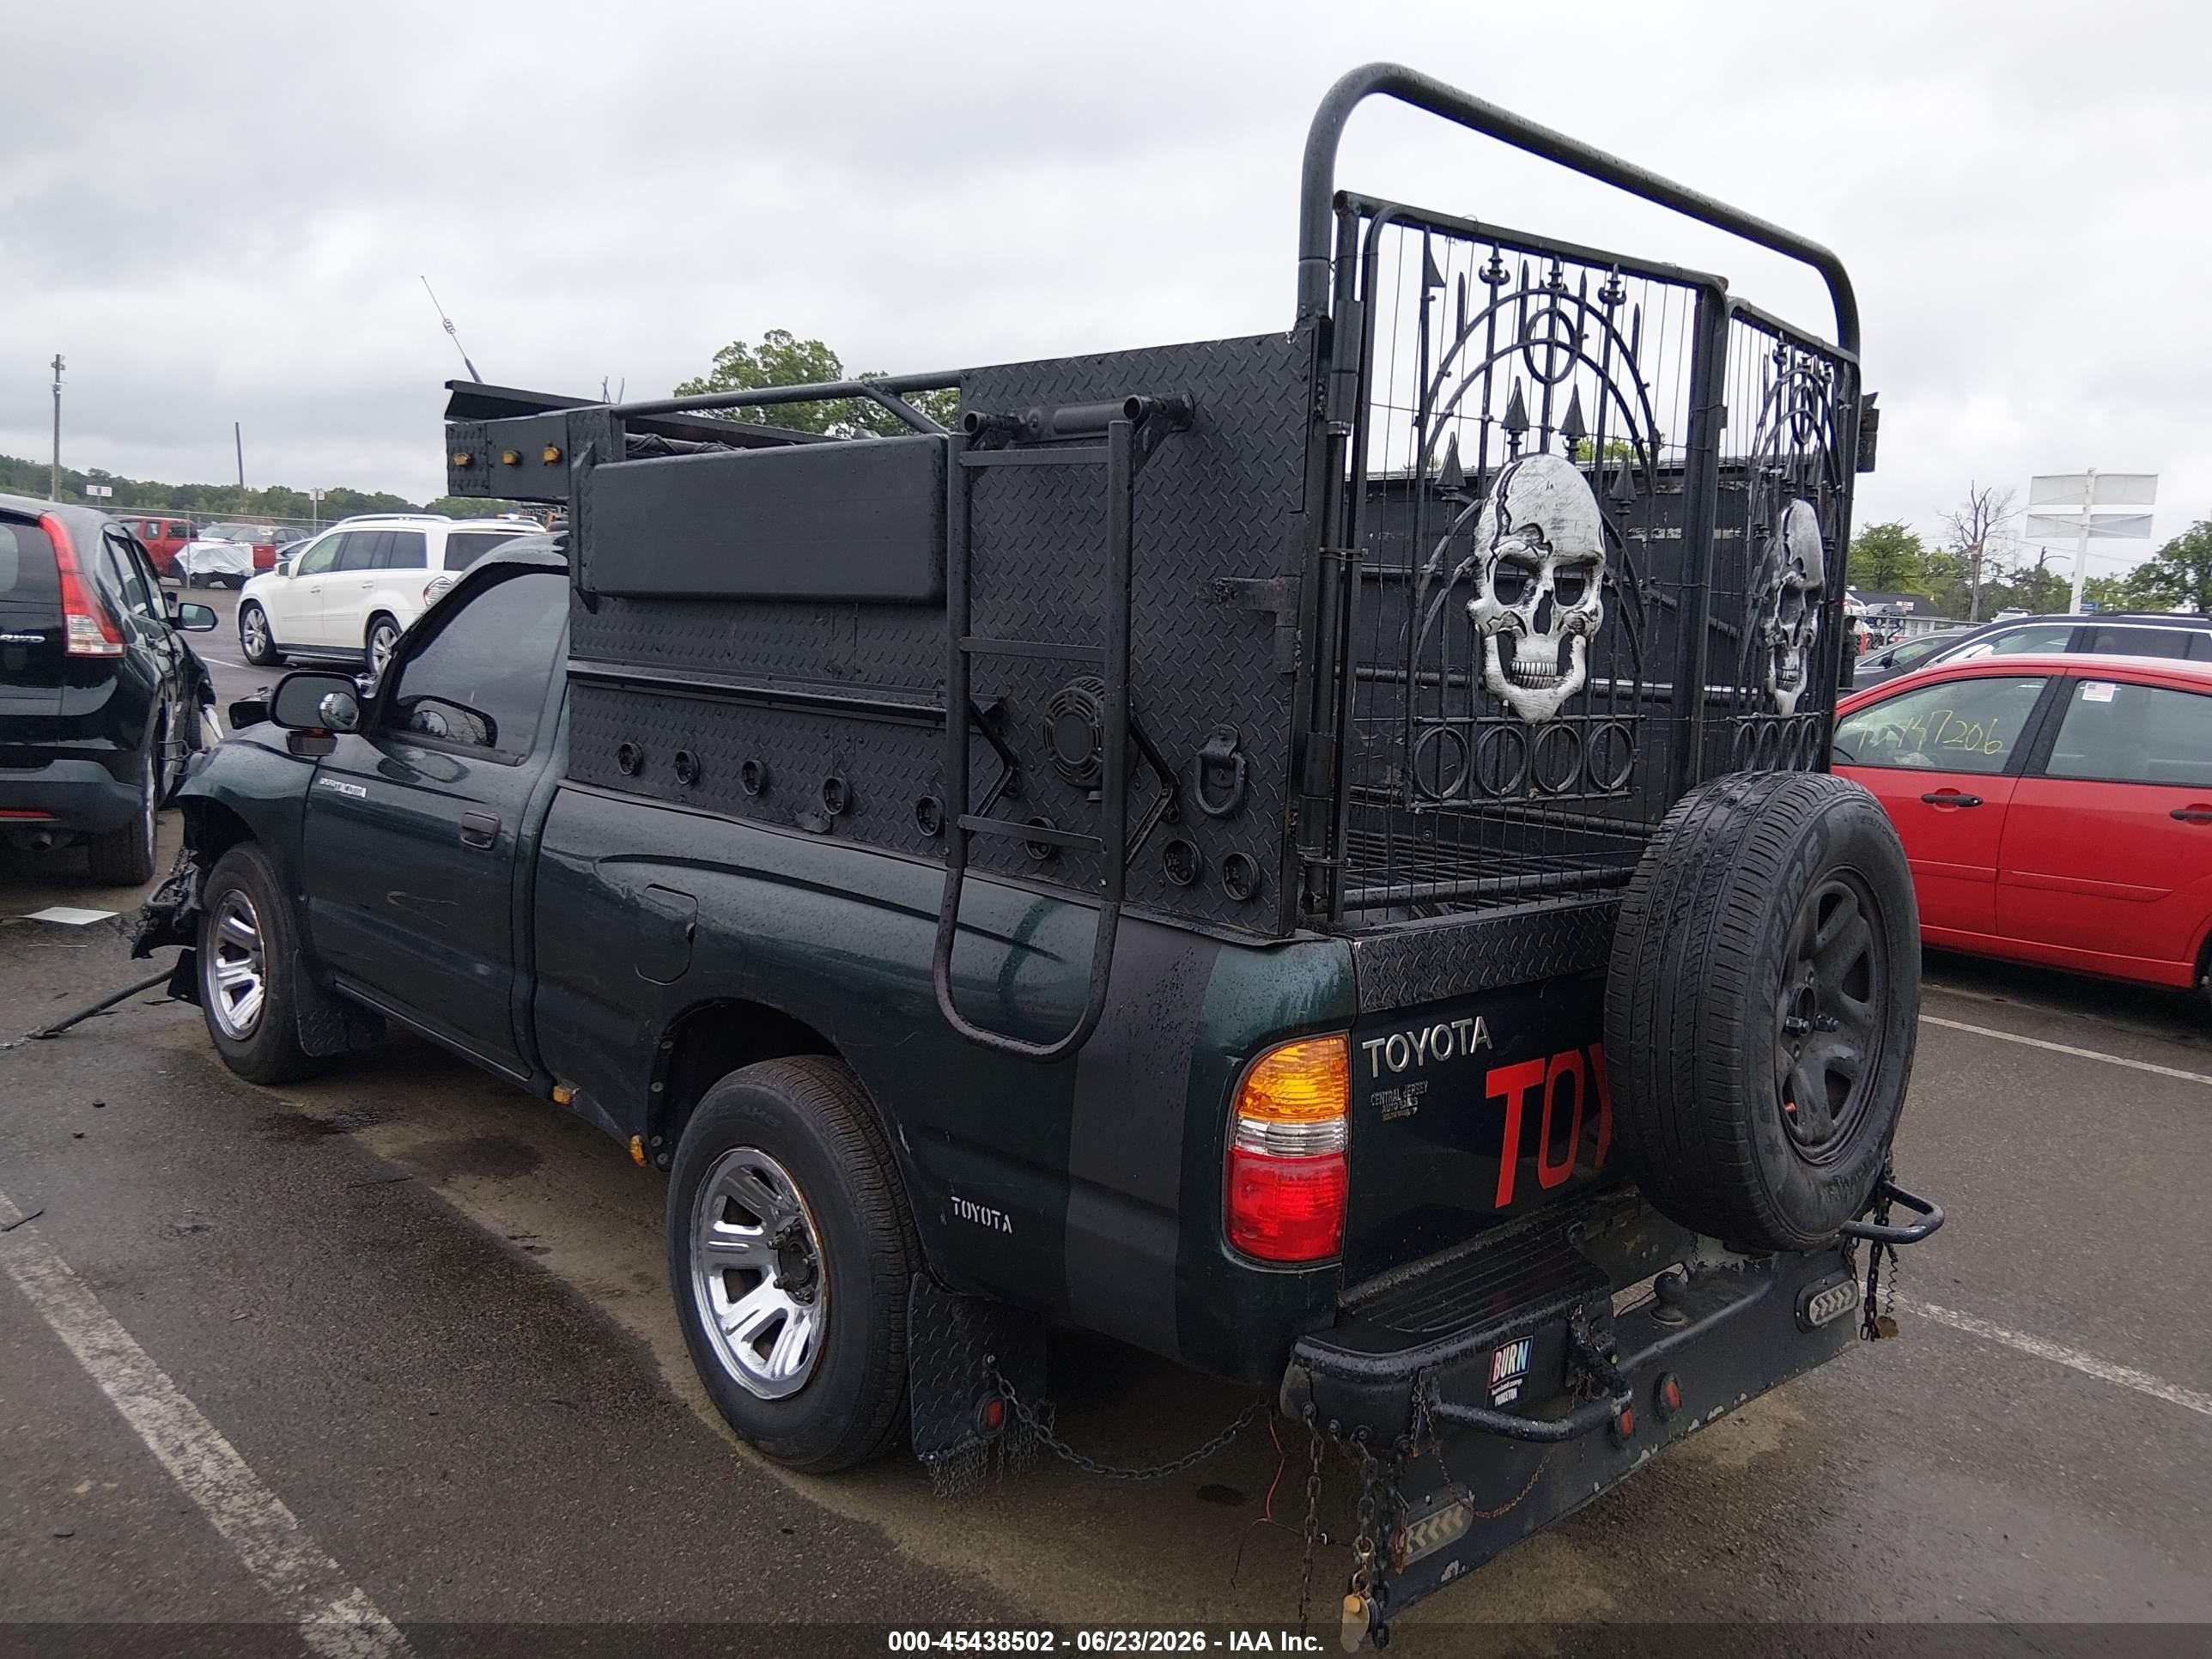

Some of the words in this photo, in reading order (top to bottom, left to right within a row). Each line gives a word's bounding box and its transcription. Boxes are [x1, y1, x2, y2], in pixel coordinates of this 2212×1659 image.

[1362, 1016, 1493, 1078] TOYOTA
[1370, 1088, 1401, 1106] CENTRAL
[1402, 1080, 1428, 1098] JERSEY
[1382, 1102, 1398, 1114] AUTO
[951, 1196, 1012, 1234] TOYOTA
[1492, 1340, 1529, 1383] BURN
